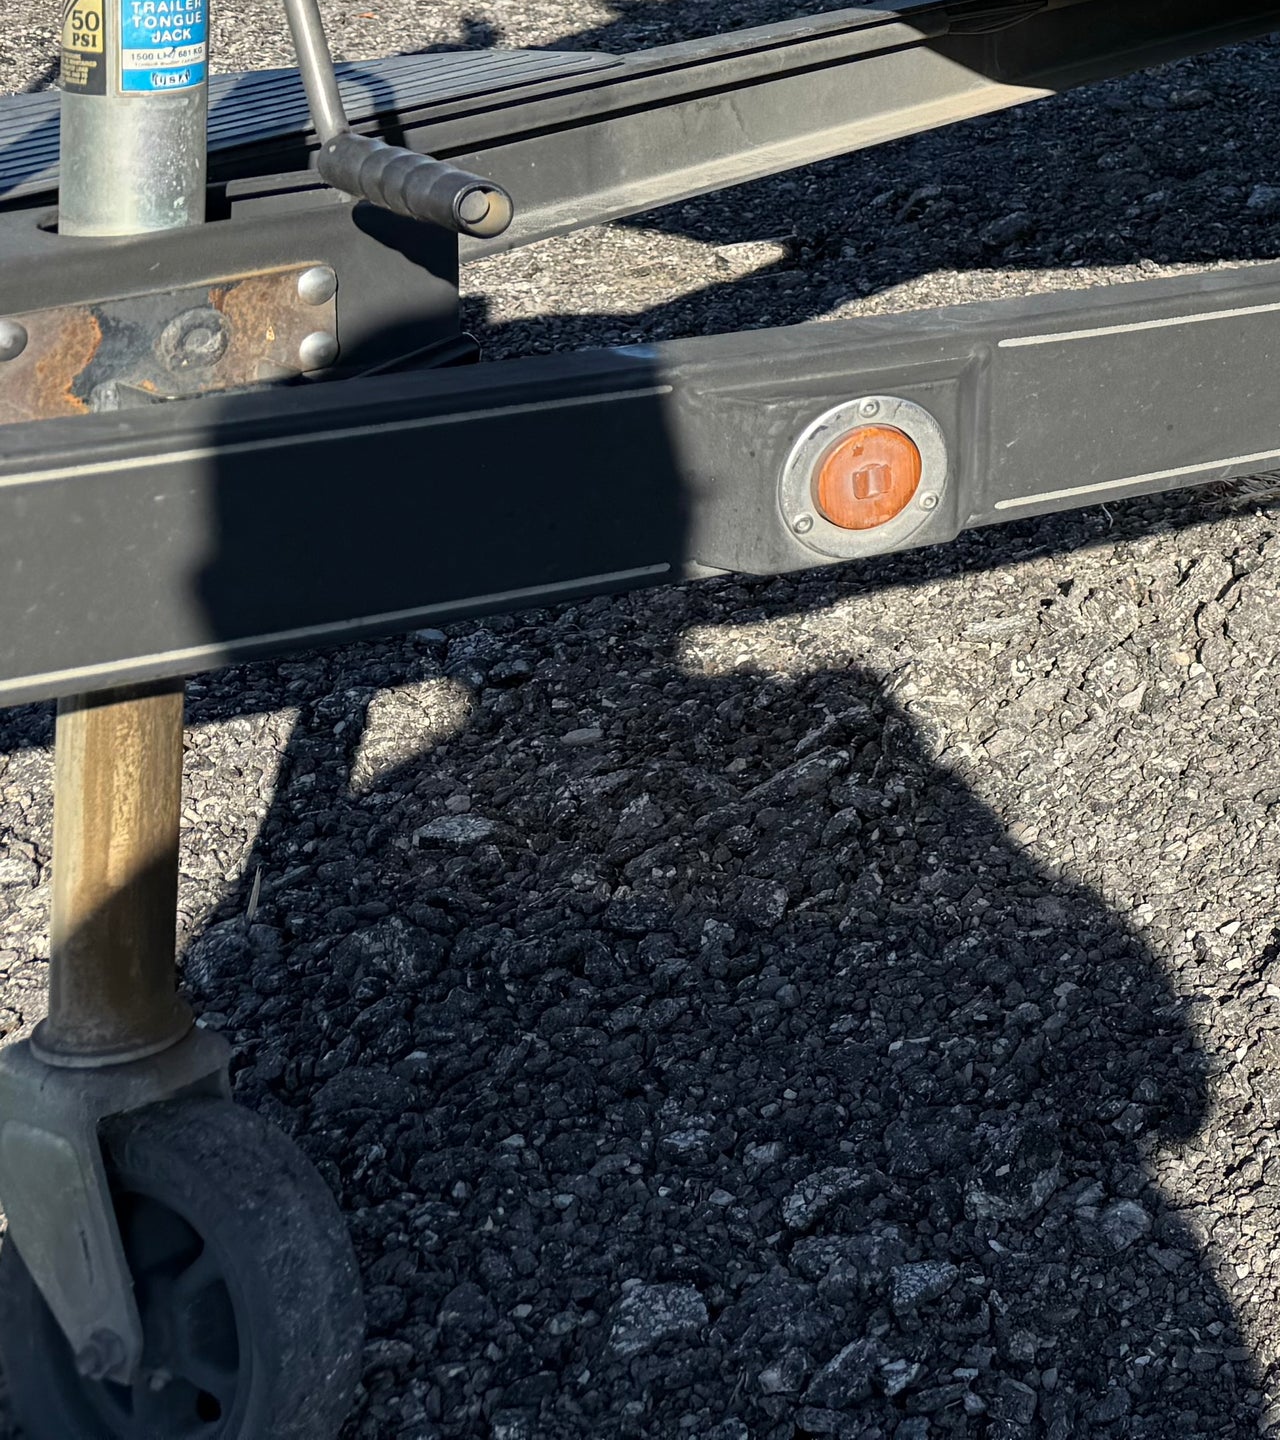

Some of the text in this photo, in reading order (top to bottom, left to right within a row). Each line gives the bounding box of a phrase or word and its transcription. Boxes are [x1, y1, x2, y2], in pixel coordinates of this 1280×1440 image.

[72, 9, 100, 32] 50
[132, 10, 202, 28] TONGUE
[72, 32, 97, 47] PSI
[152, 28, 191, 43] JACK
[131, 52, 154, 61] 1500
[193, 46, 203, 55] KG
